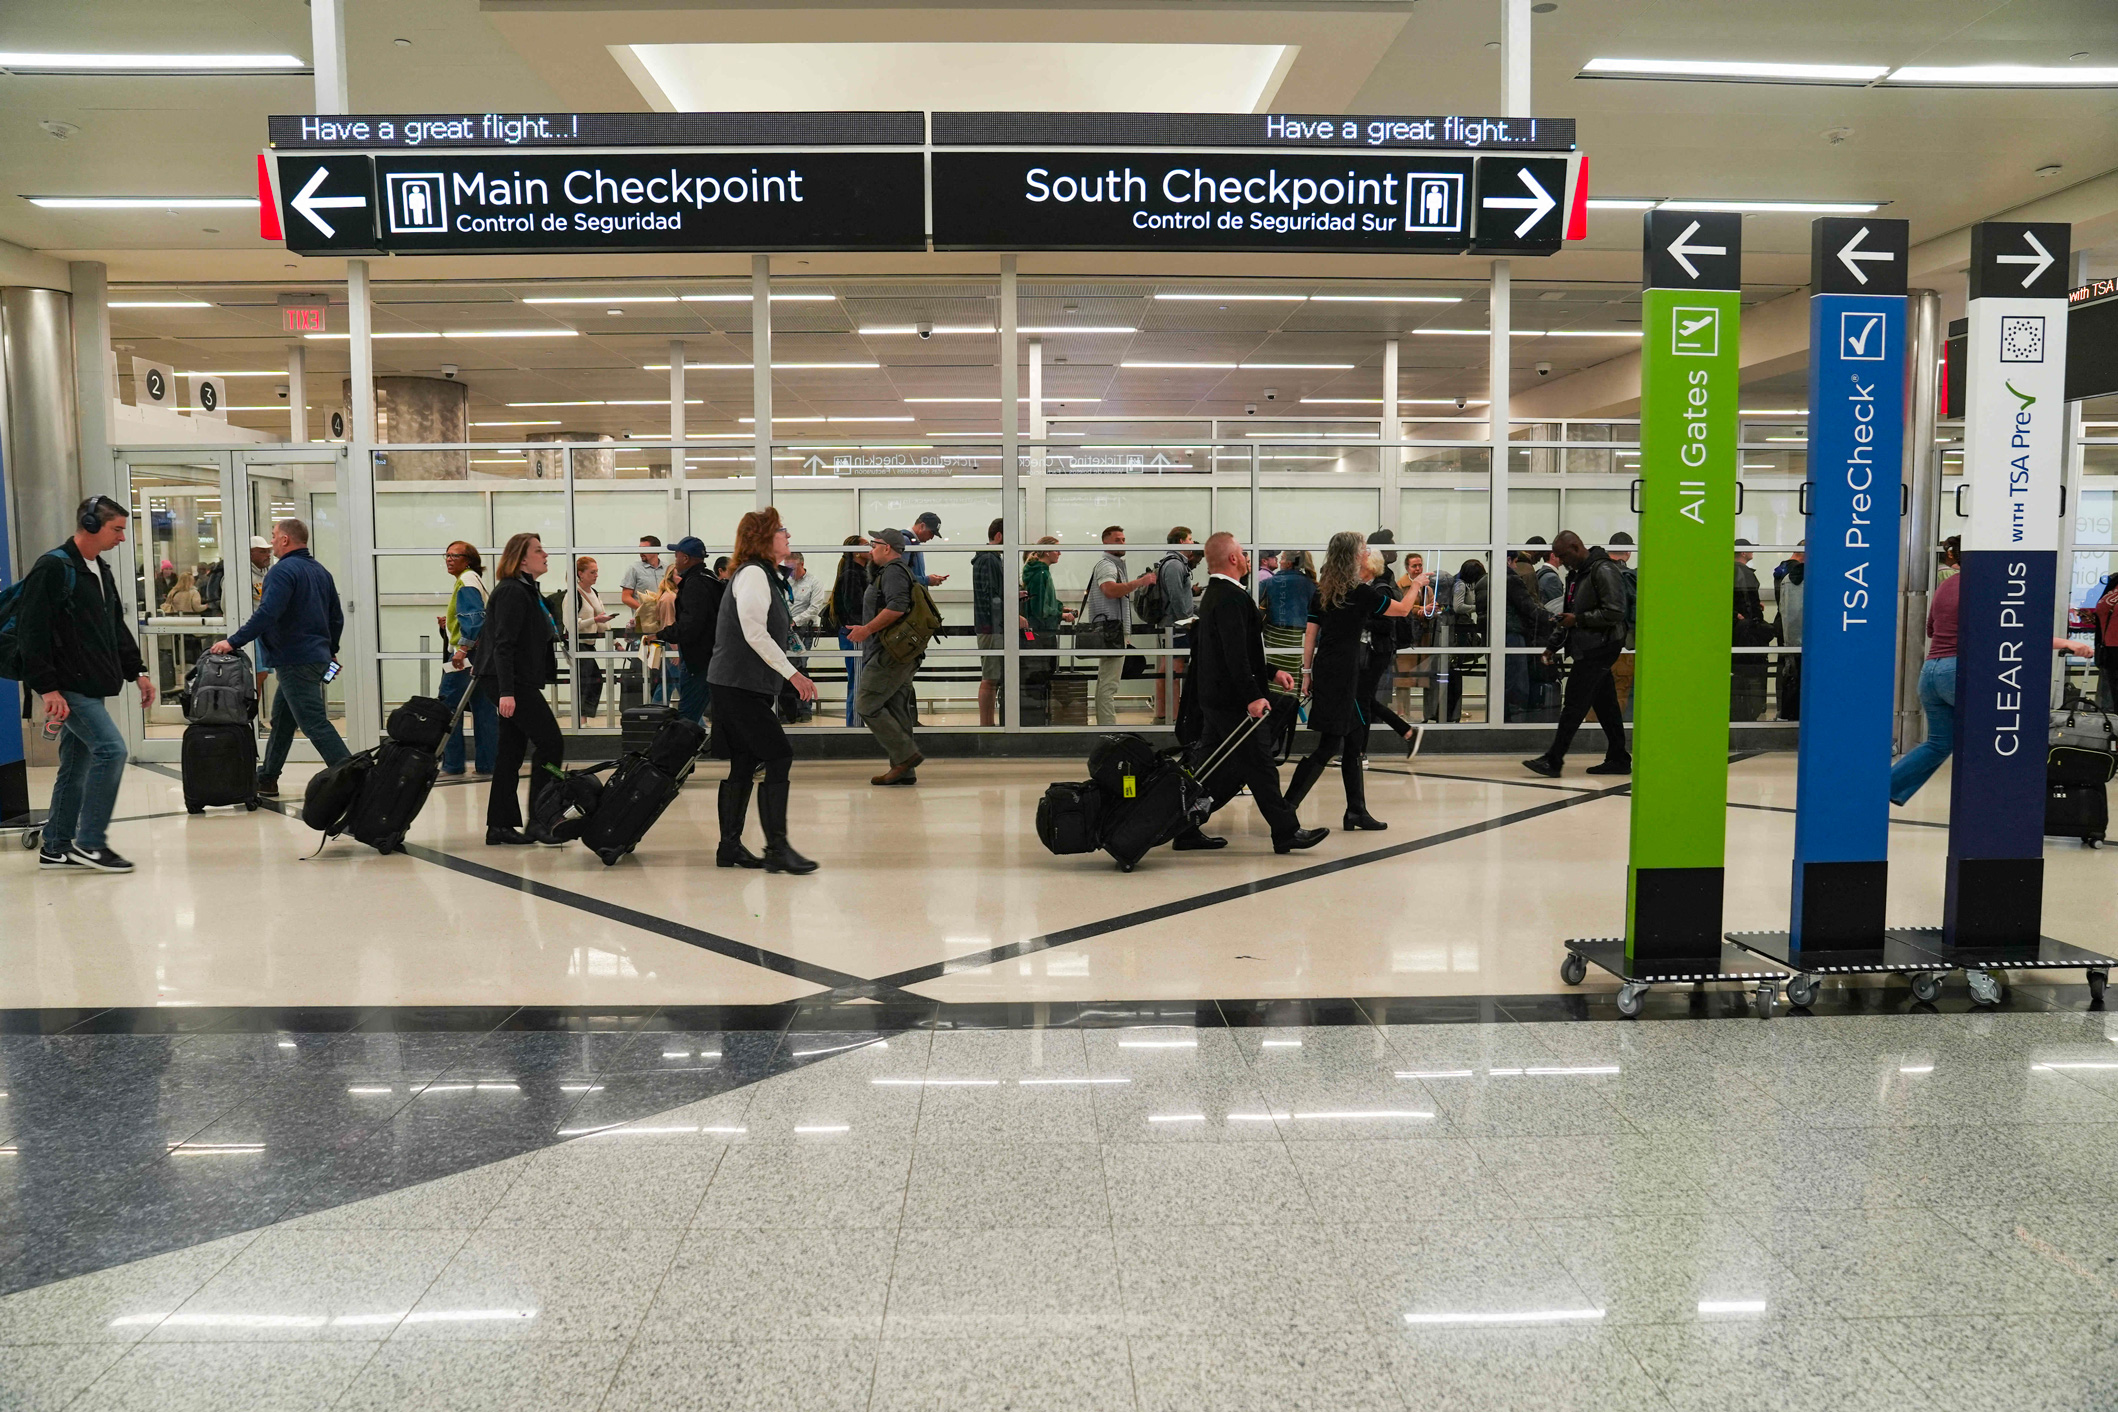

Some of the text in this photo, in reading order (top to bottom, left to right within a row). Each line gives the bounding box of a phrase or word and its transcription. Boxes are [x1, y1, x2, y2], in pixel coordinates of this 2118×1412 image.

[301, 116, 370, 141] Have
[378, 121, 395, 139] a
[404, 117, 474, 145] great
[1266, 115, 1334, 139] Have
[1342, 121, 1358, 139] a
[1367, 119, 1436, 145] great
[452, 168, 804, 210] Main Checkpoint
[1025, 167, 1399, 211] South Checkpoint
[456, 211, 682, 234] Control de Seguridad
[1132, 211, 1398, 234] Control de Seguridad Sur
[2068, 286, 2090, 303] with
[2091, 279, 2114, 298] TSA
[151, 375, 162, 395] 2
[204, 387, 213, 406] 3
[1679, 370, 1709, 525] All Gates
[2009, 454, 2030, 498] TSA
[2012, 503, 2025, 543] WITH
[1842, 561, 1870, 632] TSA
[1994, 562, 2027, 757] CLEAR Plus
